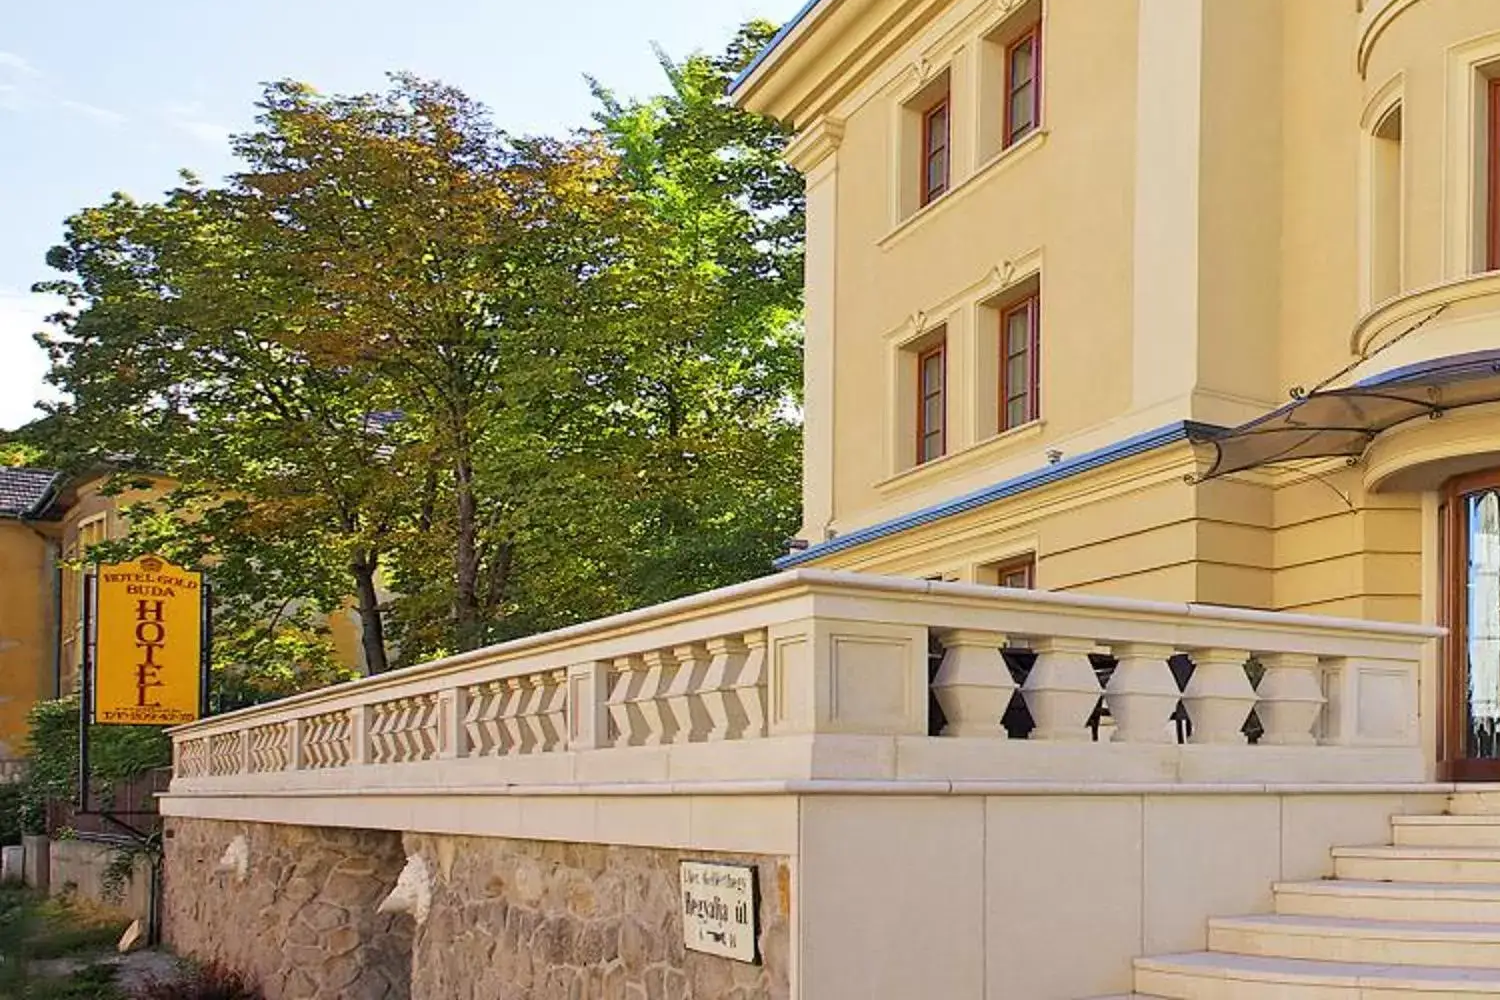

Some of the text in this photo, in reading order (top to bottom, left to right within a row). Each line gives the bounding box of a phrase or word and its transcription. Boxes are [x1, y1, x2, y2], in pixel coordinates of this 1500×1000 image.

[104, 573, 199, 590] HOTEL GOLD
[126, 584, 176, 597] BUDA
[135, 599, 165, 707] HOTEL
